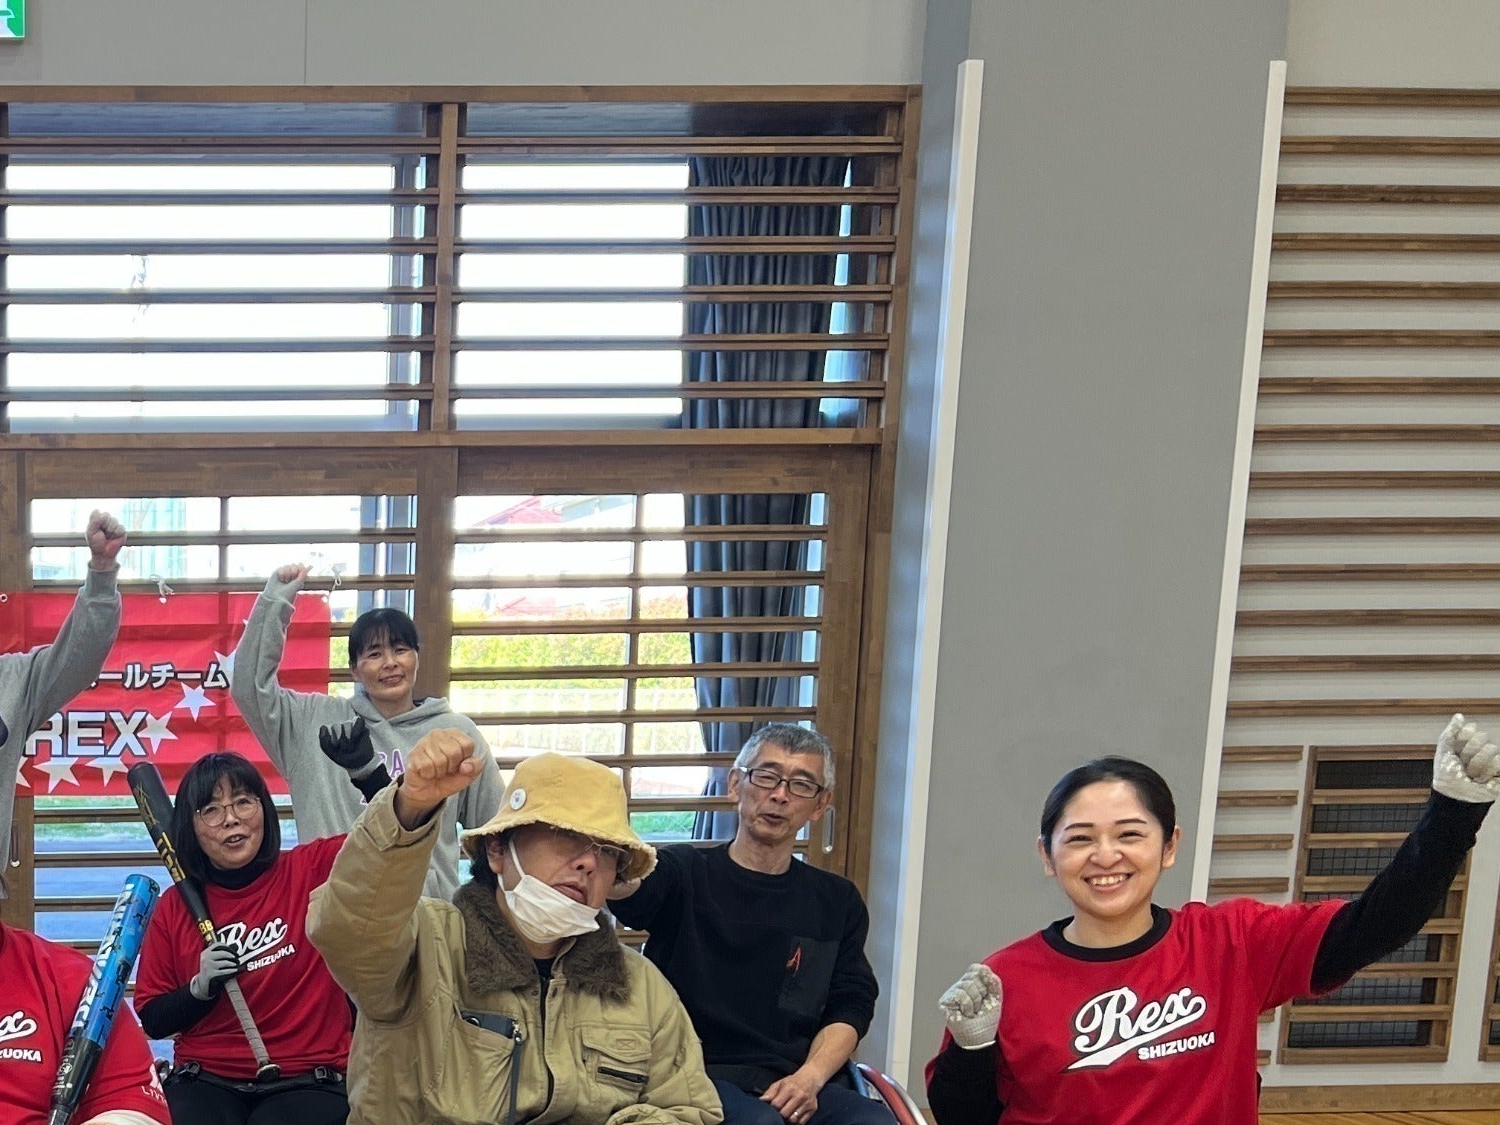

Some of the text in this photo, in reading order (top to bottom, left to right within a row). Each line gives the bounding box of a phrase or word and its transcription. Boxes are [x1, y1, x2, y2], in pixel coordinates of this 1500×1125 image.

[90, 663, 228, 689] ールチーム
[25, 711, 147, 756] REX
[1074, 986, 1207, 1056] Rex
[1137, 1031, 1216, 1061] SHIZUOKA
